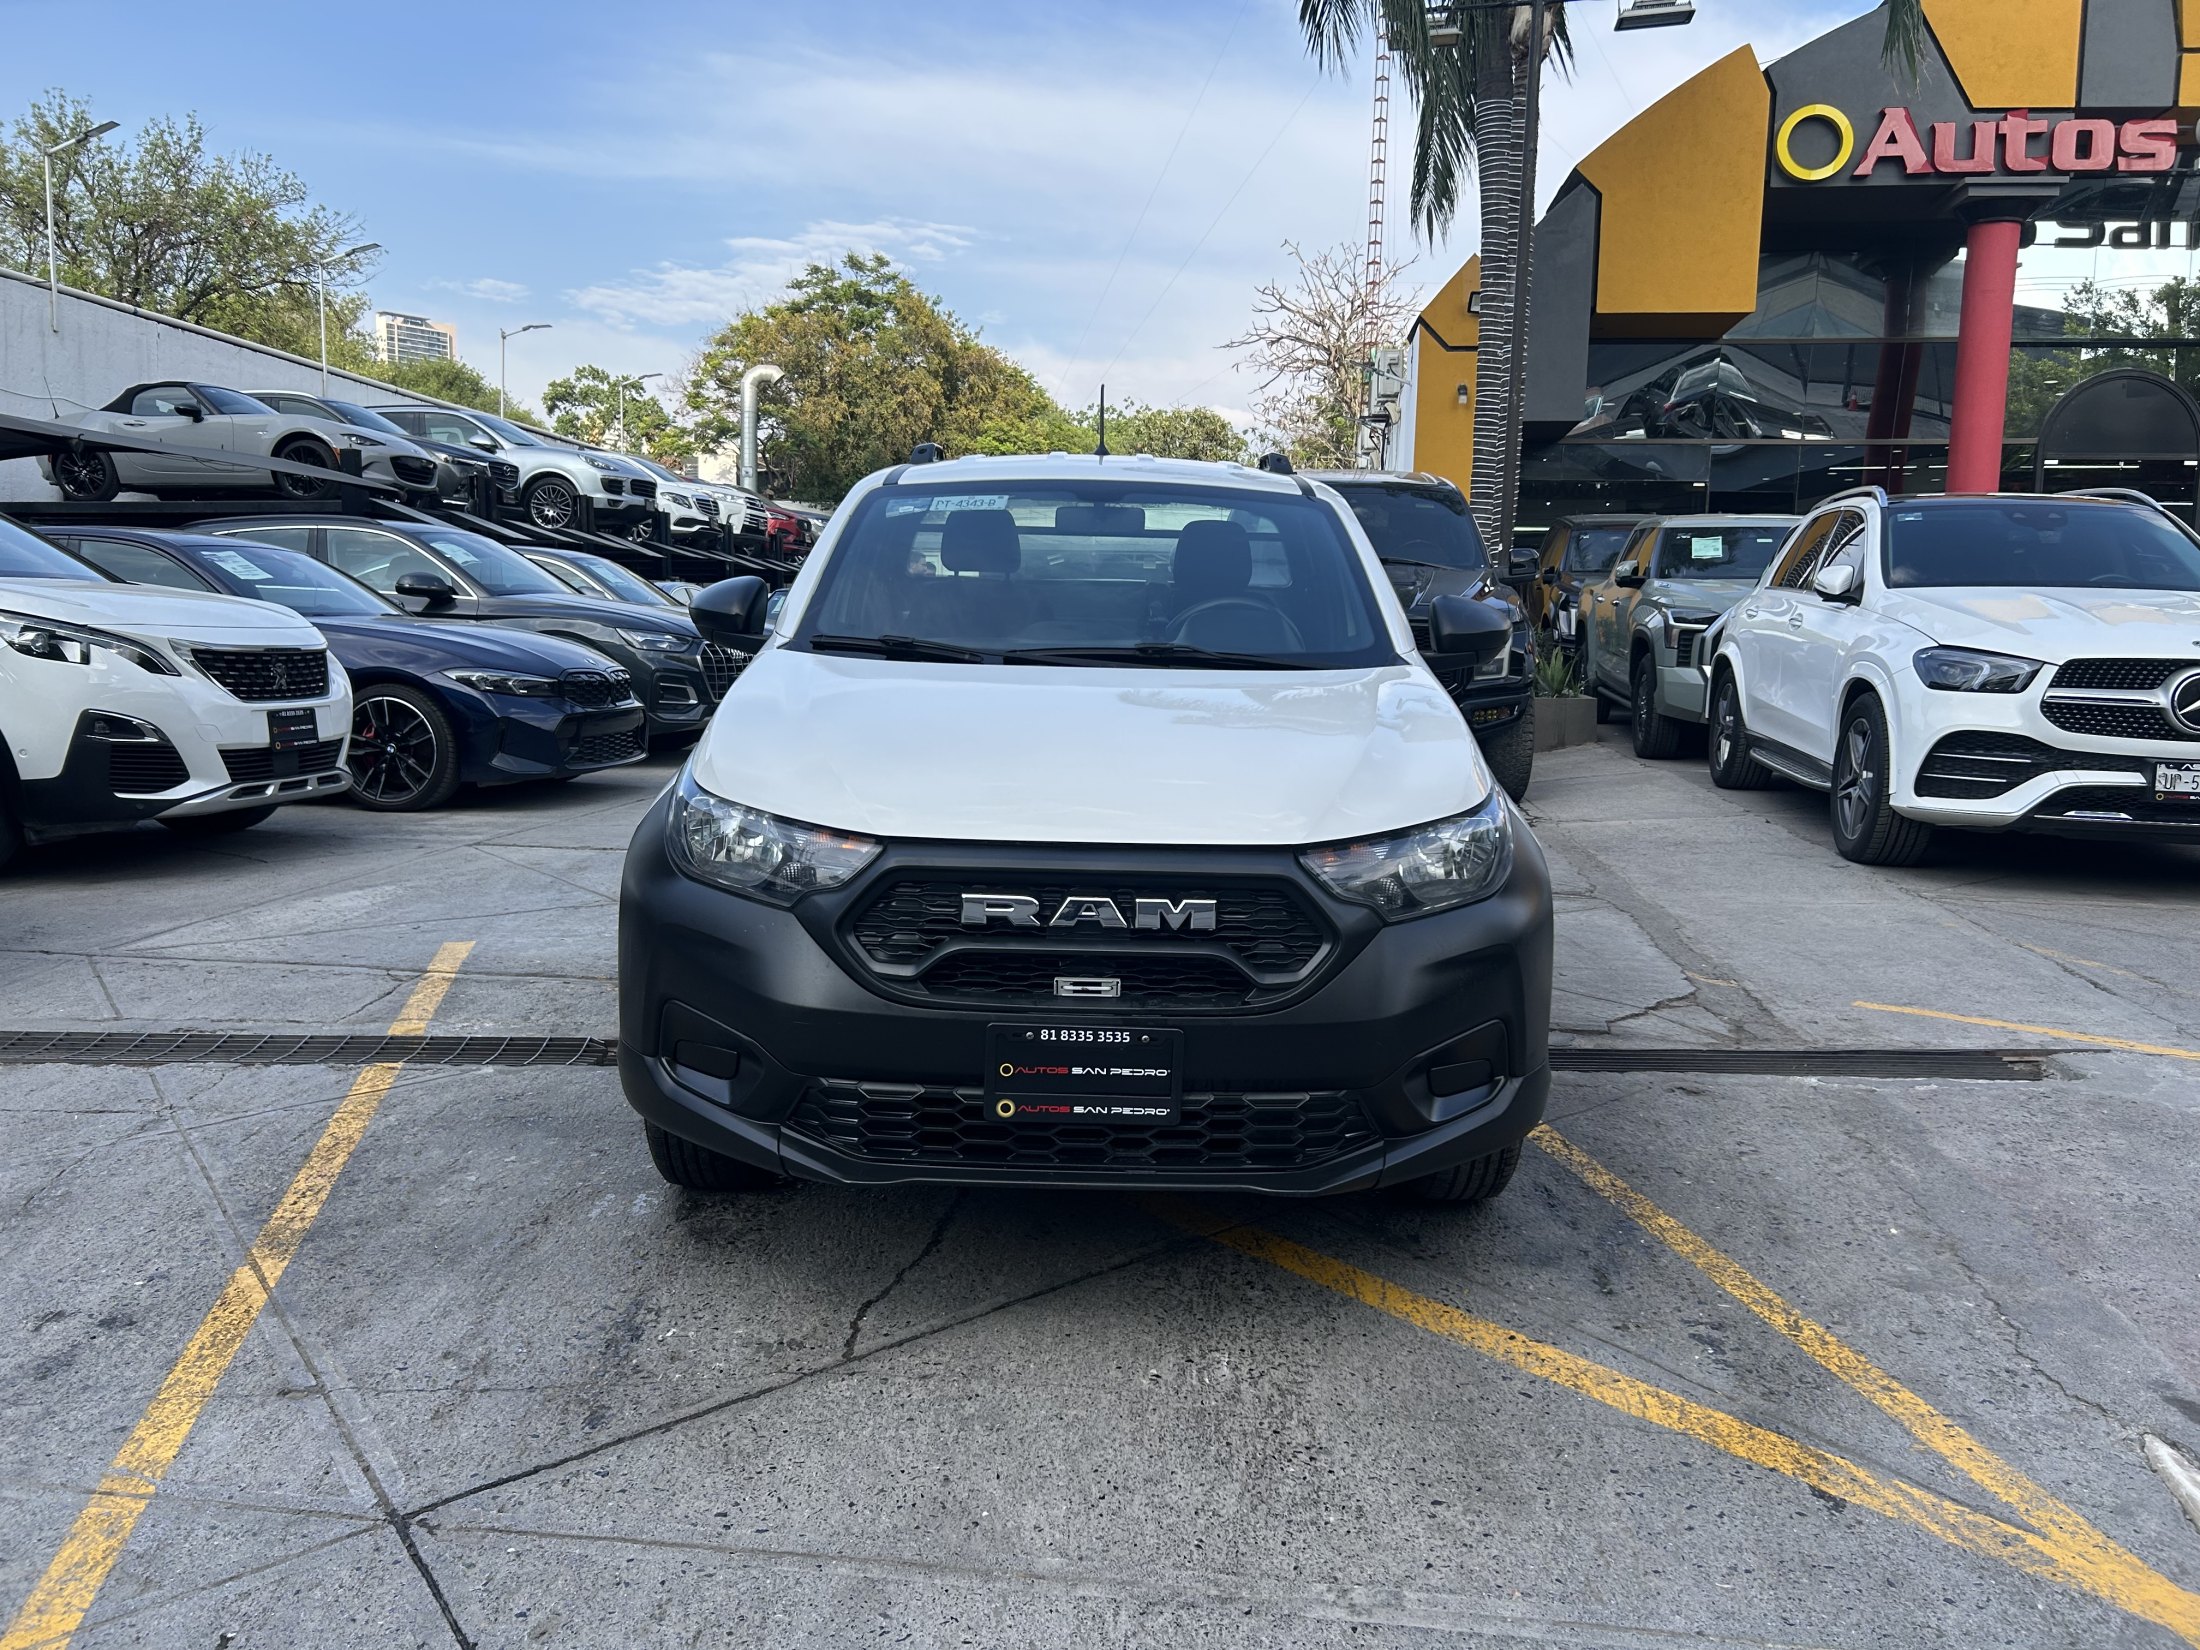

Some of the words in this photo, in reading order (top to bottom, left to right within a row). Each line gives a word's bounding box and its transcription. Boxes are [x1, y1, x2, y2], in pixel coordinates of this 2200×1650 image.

[1853, 107, 2178, 176] Autos
[960, 893, 1217, 931] RAM
[1040, 1029, 1057, 1041] 81
[1060, 1030, 1094, 1042] 8335
[1097, 1031, 1131, 1043] 3535
[1015, 1066, 1069, 1074] AUTOS
[1071, 1066, 1107, 1075] SAN
[1110, 1068, 1169, 1077] PEDRO
[1017, 1105, 1071, 1113] AUTOS
[1073, 1106, 1108, 1114] SAN
[1111, 1107, 1168, 1116] PEDRO
